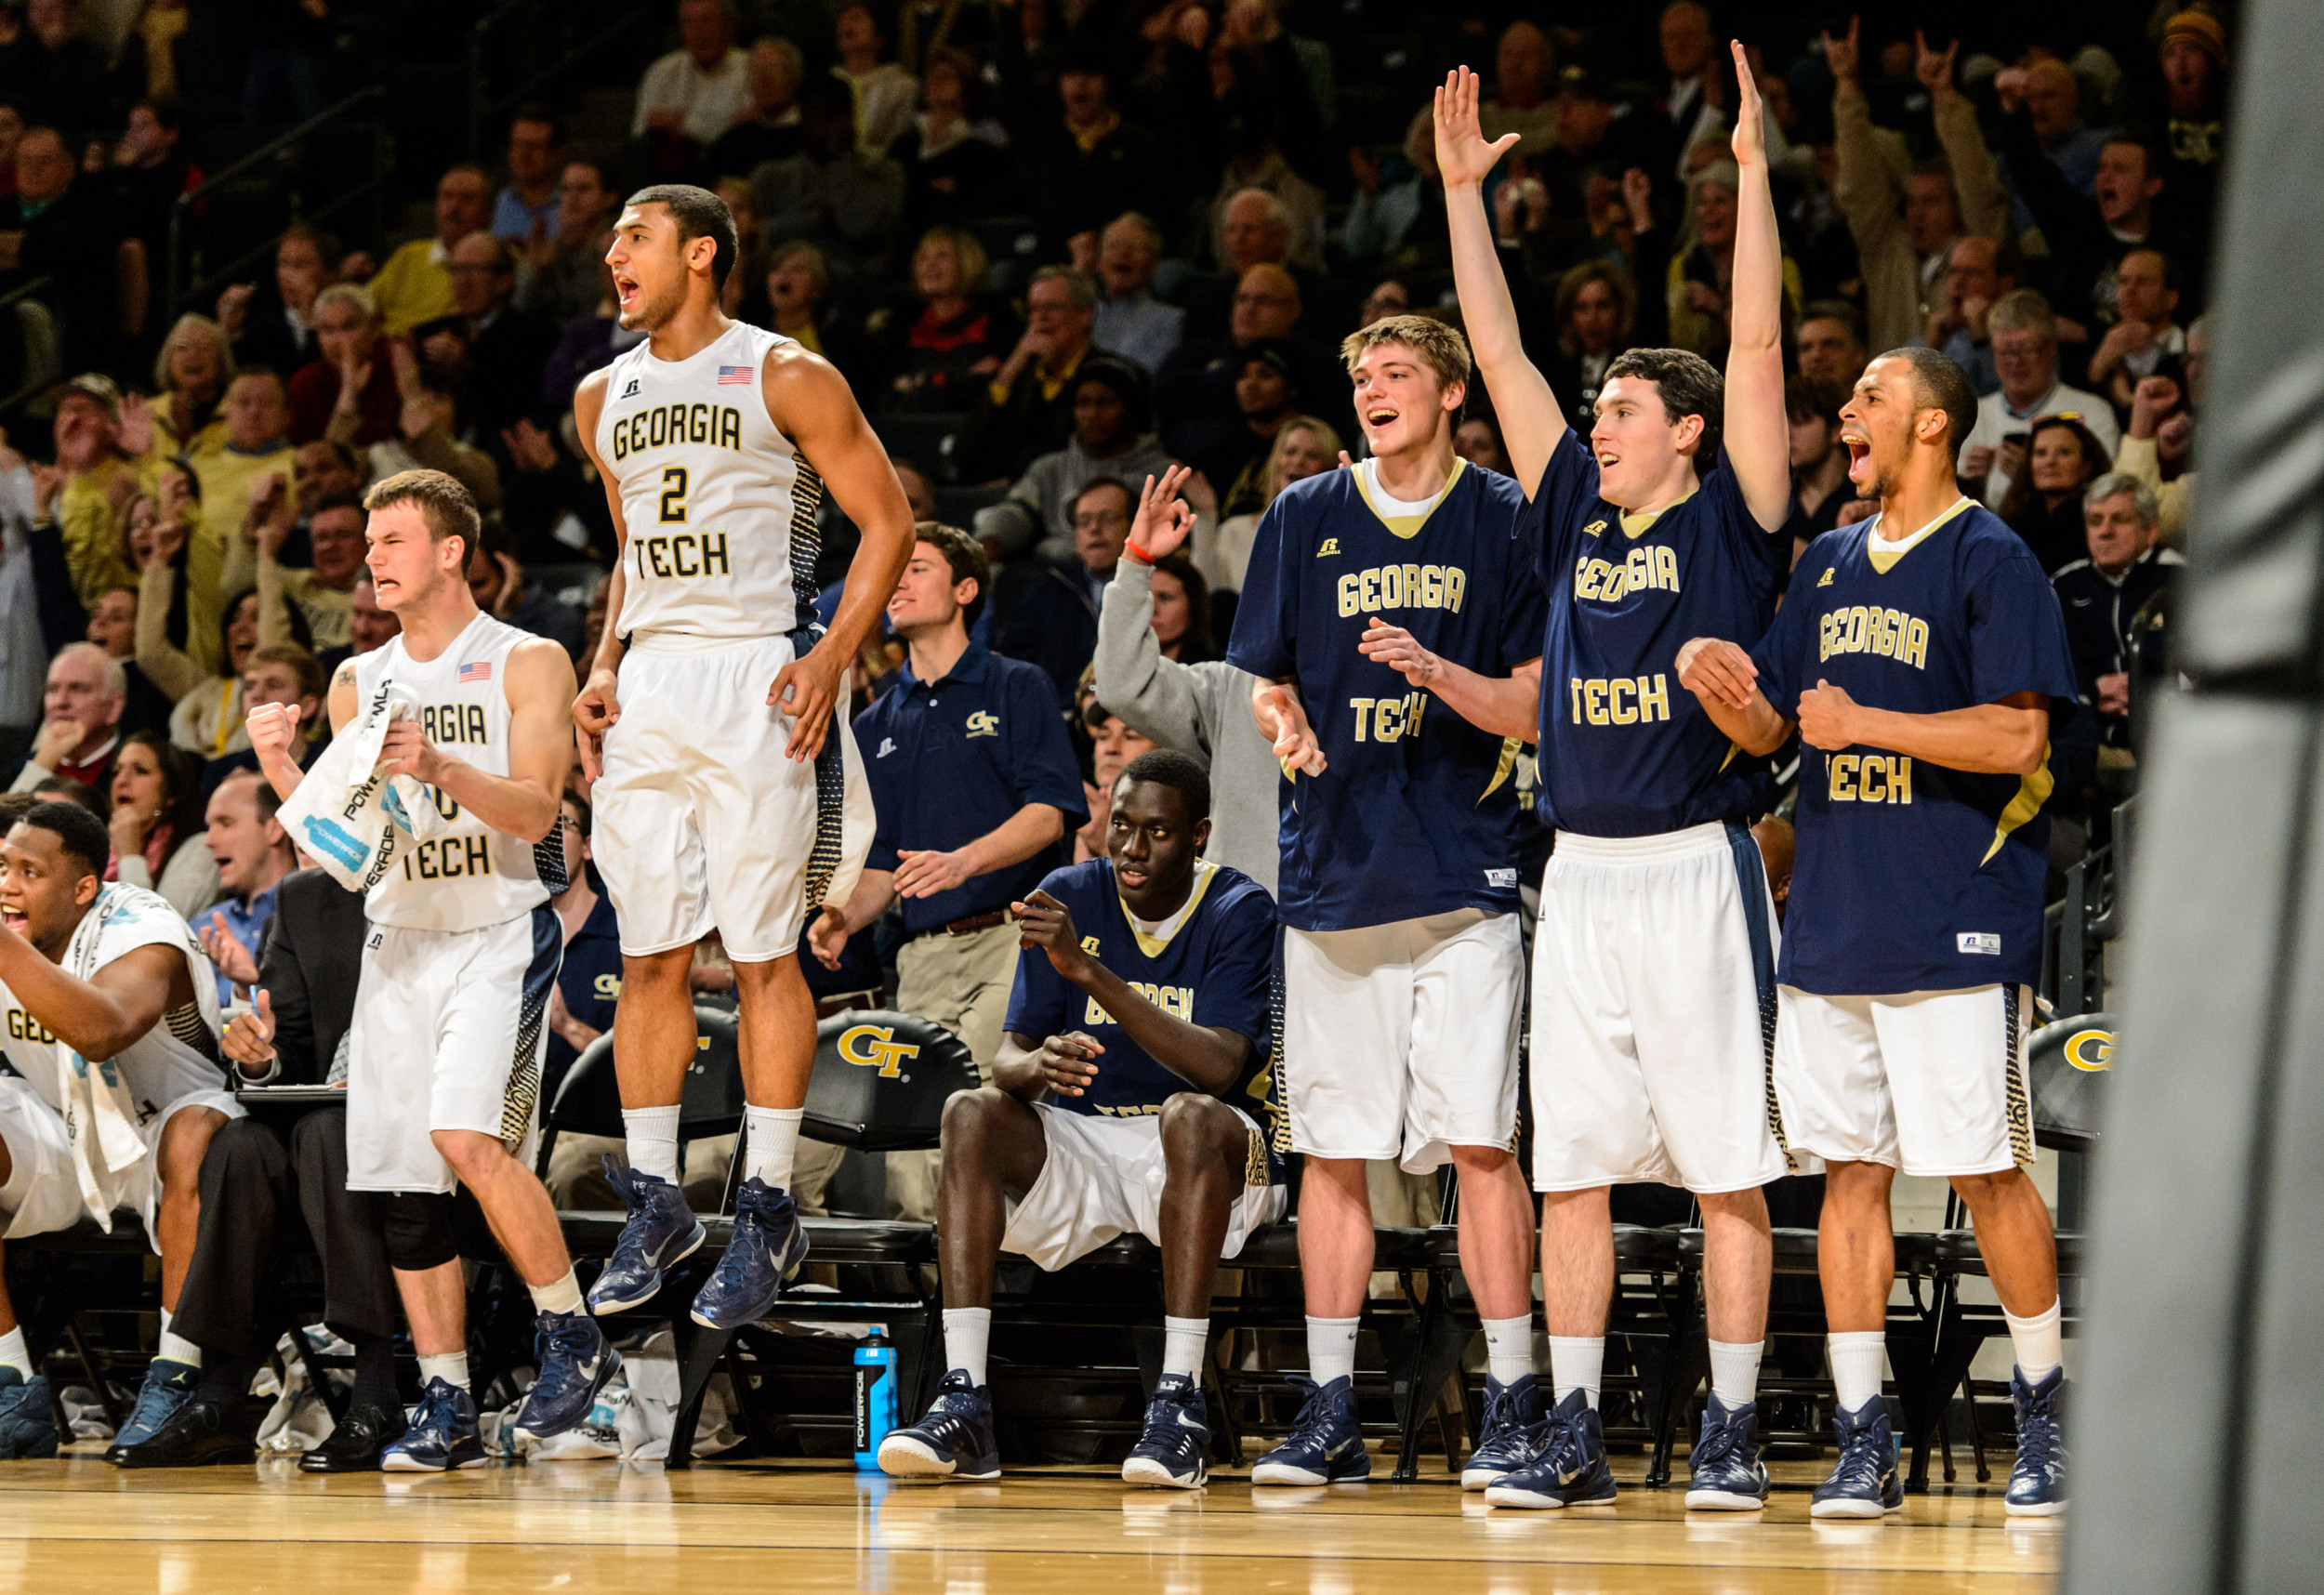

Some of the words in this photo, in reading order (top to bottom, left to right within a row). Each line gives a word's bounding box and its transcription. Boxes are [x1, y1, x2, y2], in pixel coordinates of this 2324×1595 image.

[613, 402, 742, 463] GEORGIA
[658, 466, 689, 524] 2
[633, 531, 731, 580] TECH
[1574, 545, 1681, 602] GEOGIA
[1819, 605, 1930, 670] GEORGIA
[966, 709, 1000, 732] GT
[1570, 673, 1670, 725] TECH
[1825, 754, 1912, 805] ECH
[837, 1024, 920, 1078] GT
[856, 1369, 865, 1448] POWERADE
